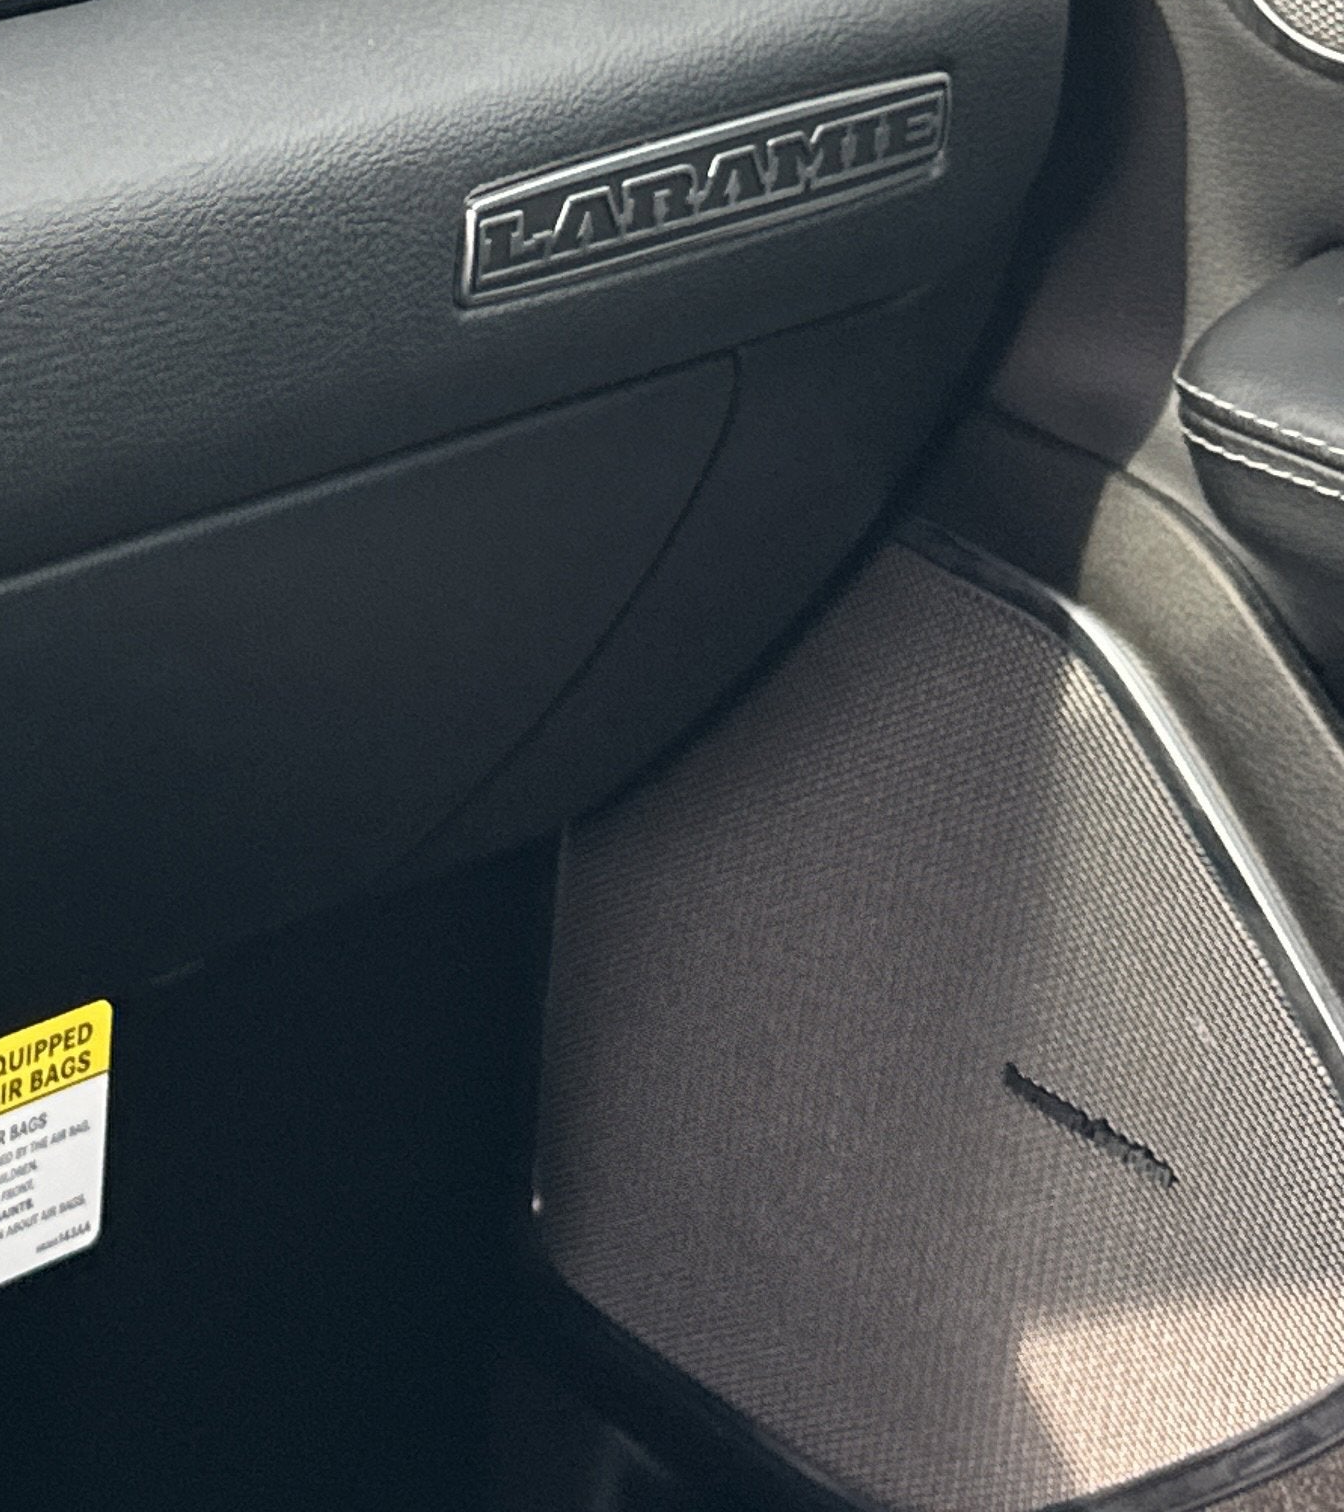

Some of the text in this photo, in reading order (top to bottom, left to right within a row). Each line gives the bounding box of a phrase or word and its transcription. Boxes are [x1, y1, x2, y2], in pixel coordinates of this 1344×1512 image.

[479, 91, 945, 283] LARAMIE
[30, 1050, 91, 1093] BAGS
[9, 1112, 48, 1141] BAGS
